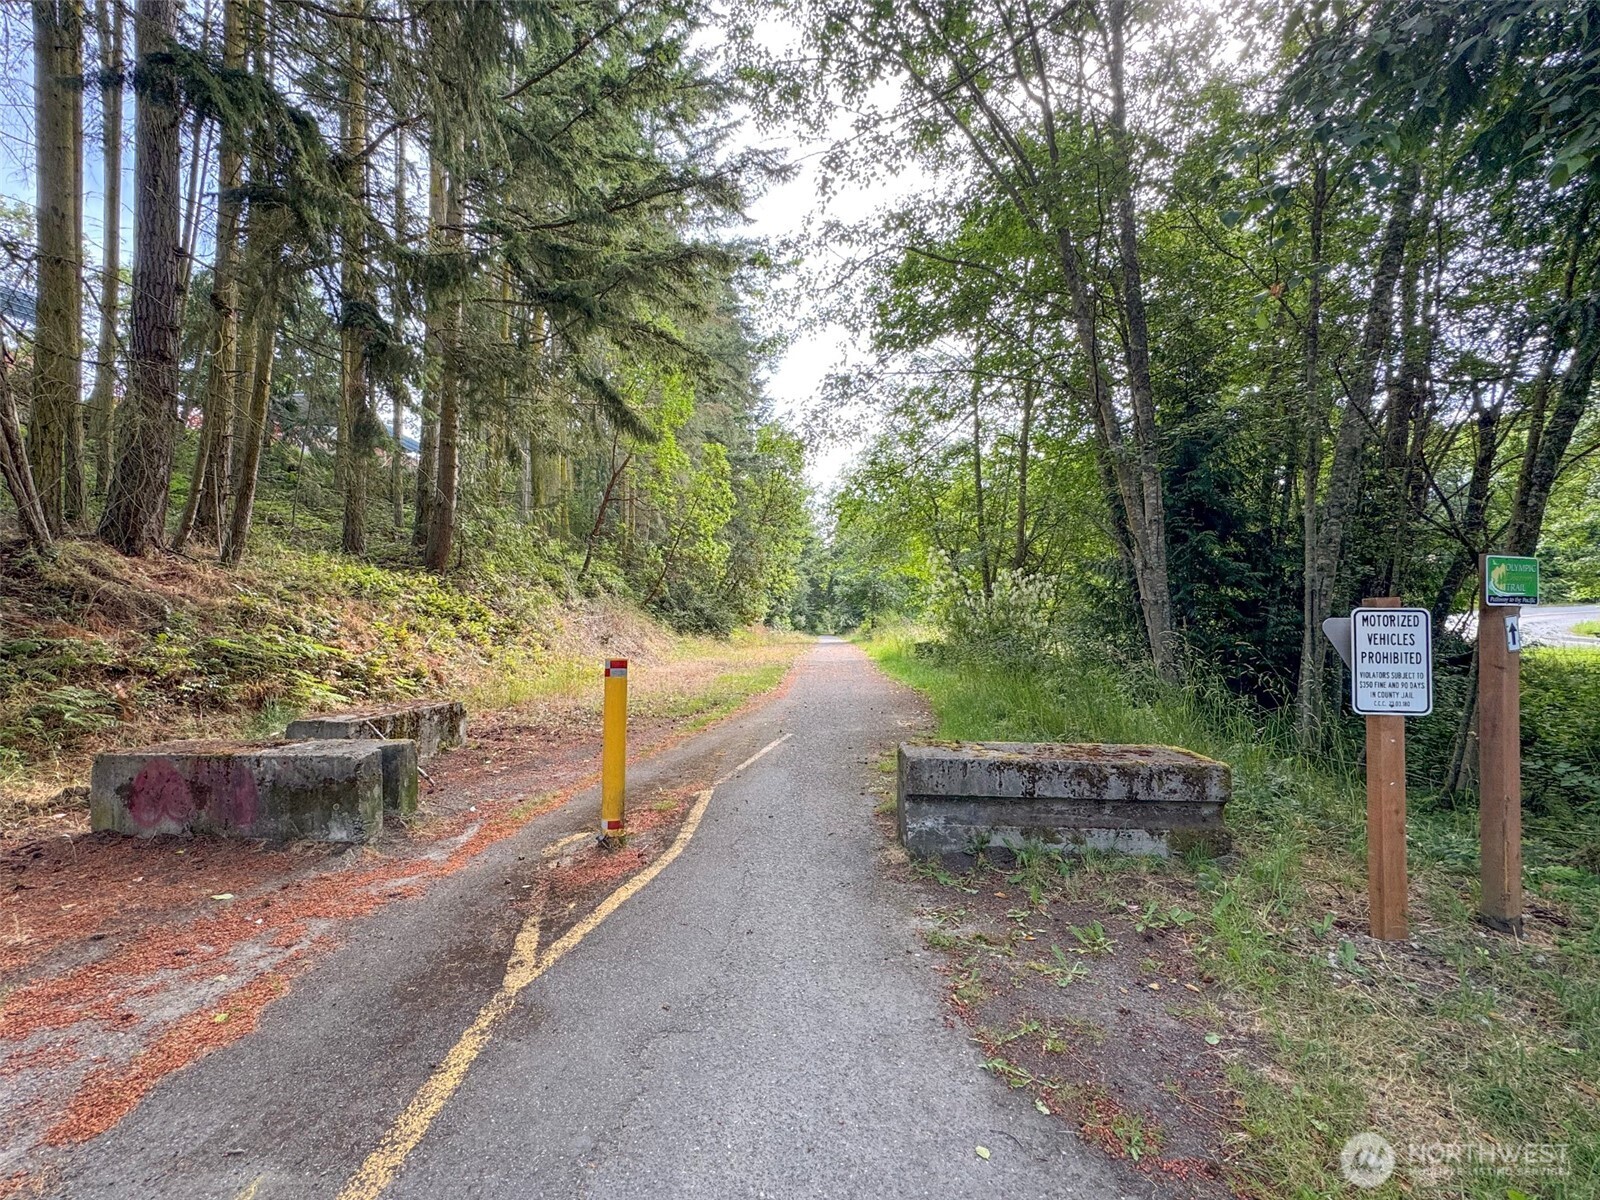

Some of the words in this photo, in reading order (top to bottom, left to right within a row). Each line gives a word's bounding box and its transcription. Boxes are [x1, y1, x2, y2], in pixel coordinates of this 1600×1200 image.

[1506, 564, 1536, 572] OLYMPIC
[1506, 584, 1526, 592] TRAIL
[1362, 614, 1420, 628] MOTORIZED
[1367, 633, 1416, 646] VEHICLES
[1361, 652, 1422, 664] PROHIBITED
